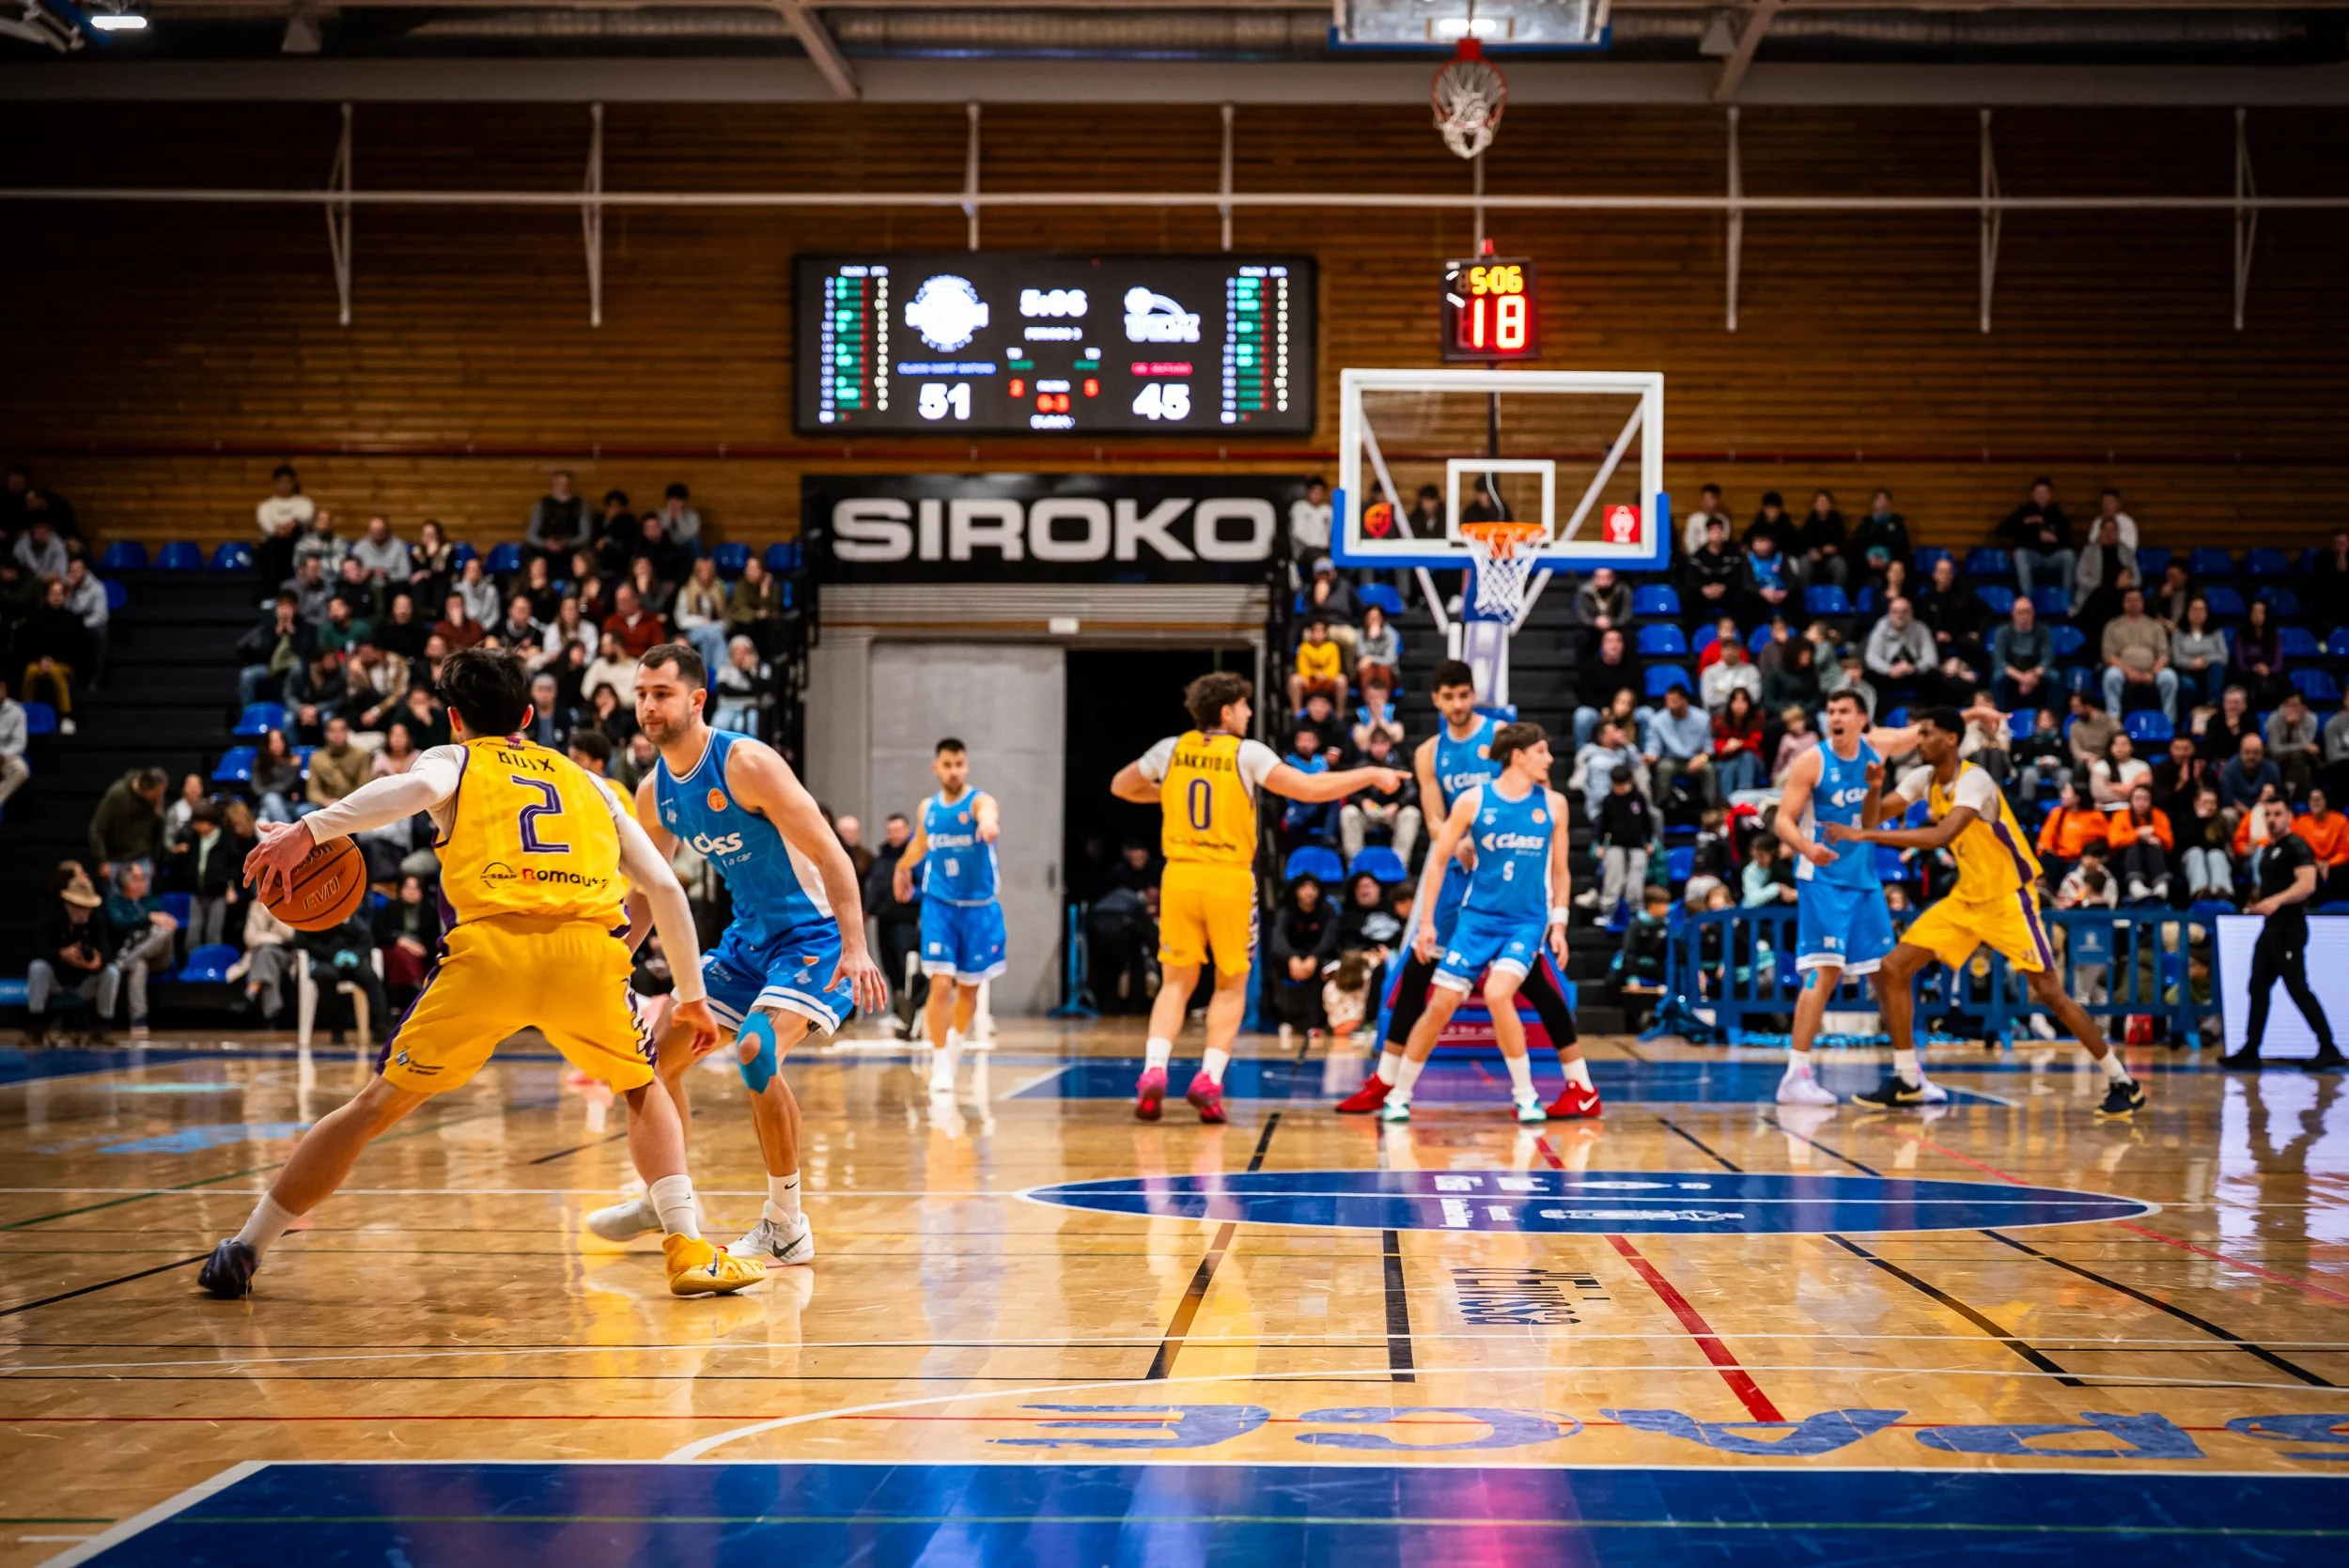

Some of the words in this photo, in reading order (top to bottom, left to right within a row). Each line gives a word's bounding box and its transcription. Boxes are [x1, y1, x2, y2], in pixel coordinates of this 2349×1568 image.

[1470, 266, 1523, 295] 5:06
[1472, 295, 1526, 349] 18
[918, 382, 971, 420] 51
[1132, 382, 1191, 420] 45
[832, 498, 1276, 562] SIROKO
[511, 774, 571, 854] 2
[1188, 779, 1212, 831] 0
